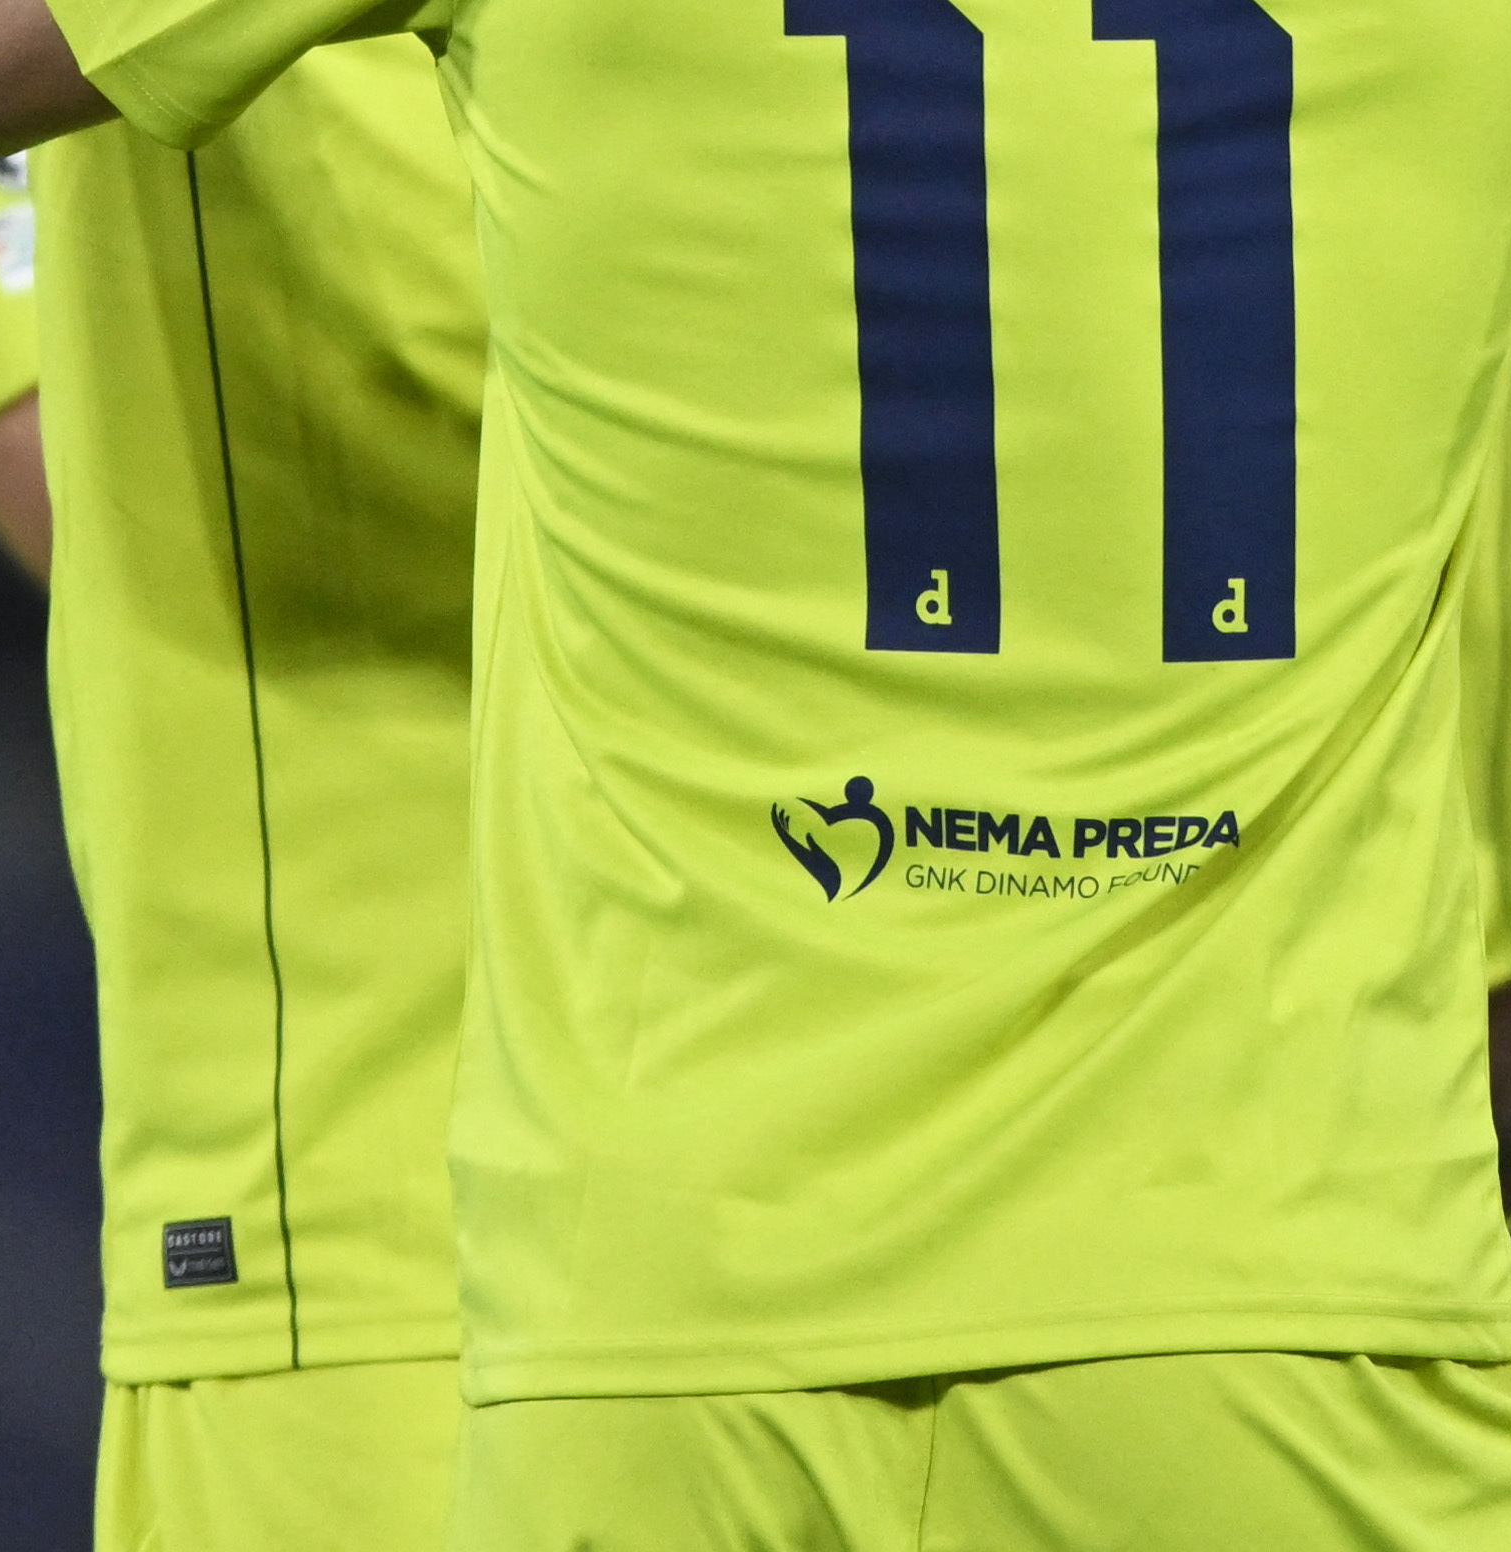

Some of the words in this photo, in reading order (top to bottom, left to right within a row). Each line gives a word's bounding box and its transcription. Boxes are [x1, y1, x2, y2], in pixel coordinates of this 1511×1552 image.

[905, 805, 1061, 858] NEMA
[1073, 810, 1239, 859] PREDA
[905, 864, 967, 892] GNK
[975, 870, 1100, 899] DINAMO
